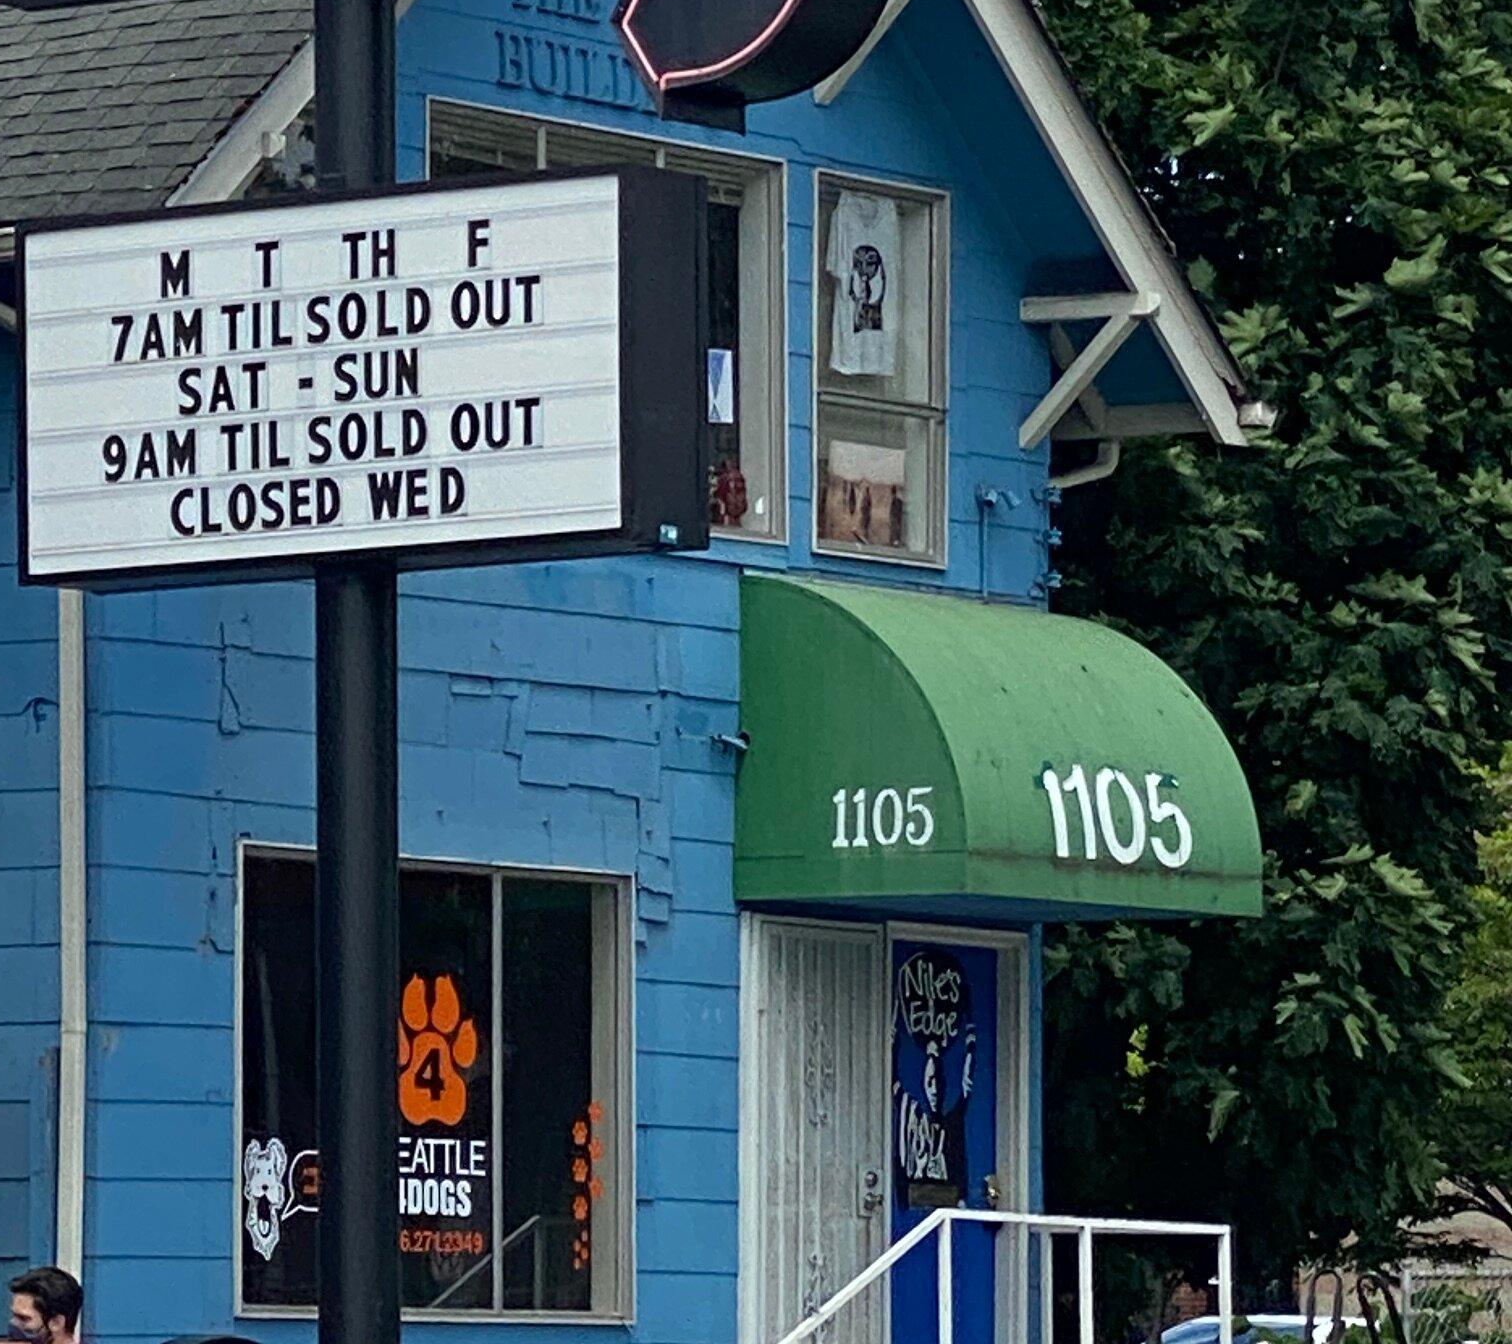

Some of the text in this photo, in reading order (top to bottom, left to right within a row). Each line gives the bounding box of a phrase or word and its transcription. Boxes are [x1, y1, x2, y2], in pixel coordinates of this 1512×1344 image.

[494, 28, 648, 113] BUILD
[160, 219, 490, 299] M T TH F
[111, 274, 541, 364] 7AM TIL SOLD OUT
[178, 361, 267, 417] SAT
[333, 346, 420, 403] SUN
[104, 397, 541, 483] 9AM TIL SOLD OUT
[170, 467, 466, 537] CLOSED WED
[831, 785, 935, 849] 1105
[1041, 763, 1193, 869] 1105
[414, 1046, 445, 1102] 4
[398, 1136, 487, 1176] EATTLE
